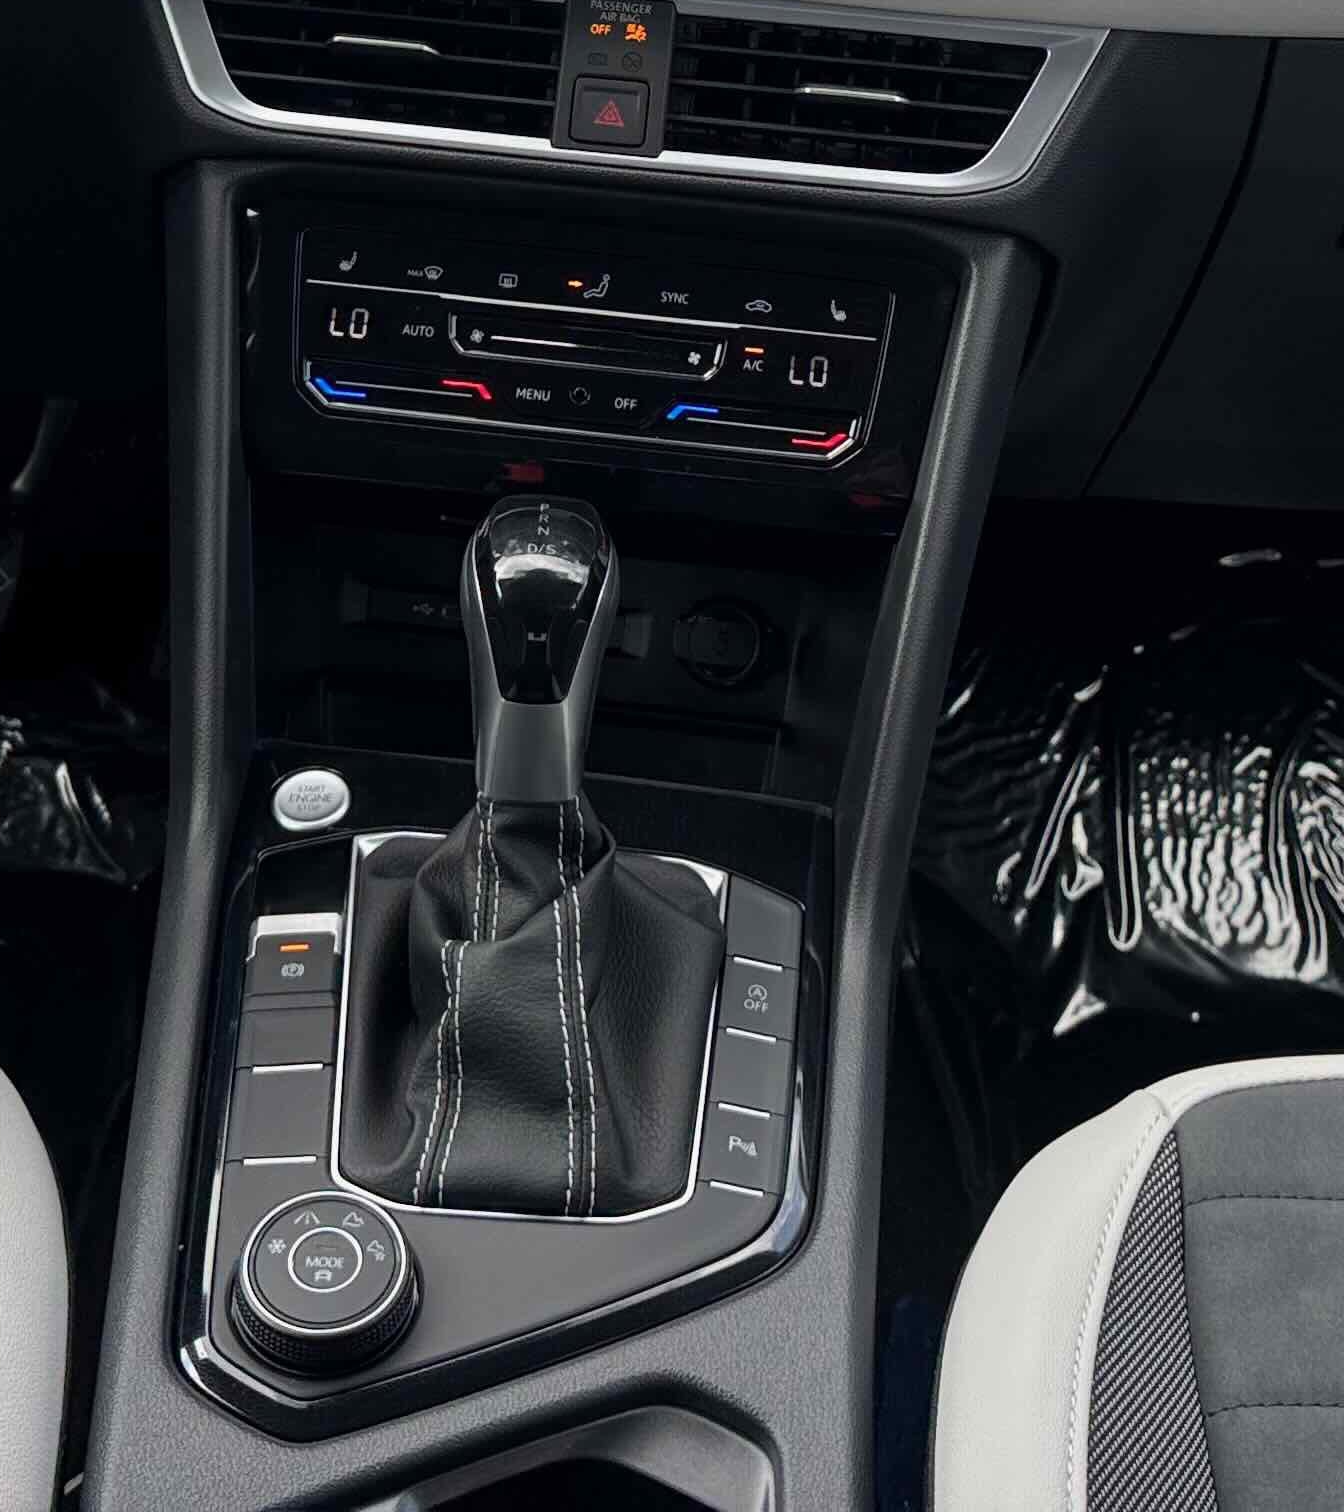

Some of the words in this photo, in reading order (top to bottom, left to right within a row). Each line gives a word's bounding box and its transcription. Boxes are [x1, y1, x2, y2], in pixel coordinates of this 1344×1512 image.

[590, 0, 653, 14] PASSENGER
[590, 23, 612, 36] OFF
[660, 291, 689, 306] SYNC
[402, 323, 434, 338] AUTO
[742, 358, 764, 373] A/C
[515, 387, 551, 403] MENU
[614, 397, 638, 411] OFF
[537, 526, 550, 536] N
[527, 543, 557, 555] D/S
[743, 998, 769, 1013] OFF
[305, 1255, 345, 1269] MODE
